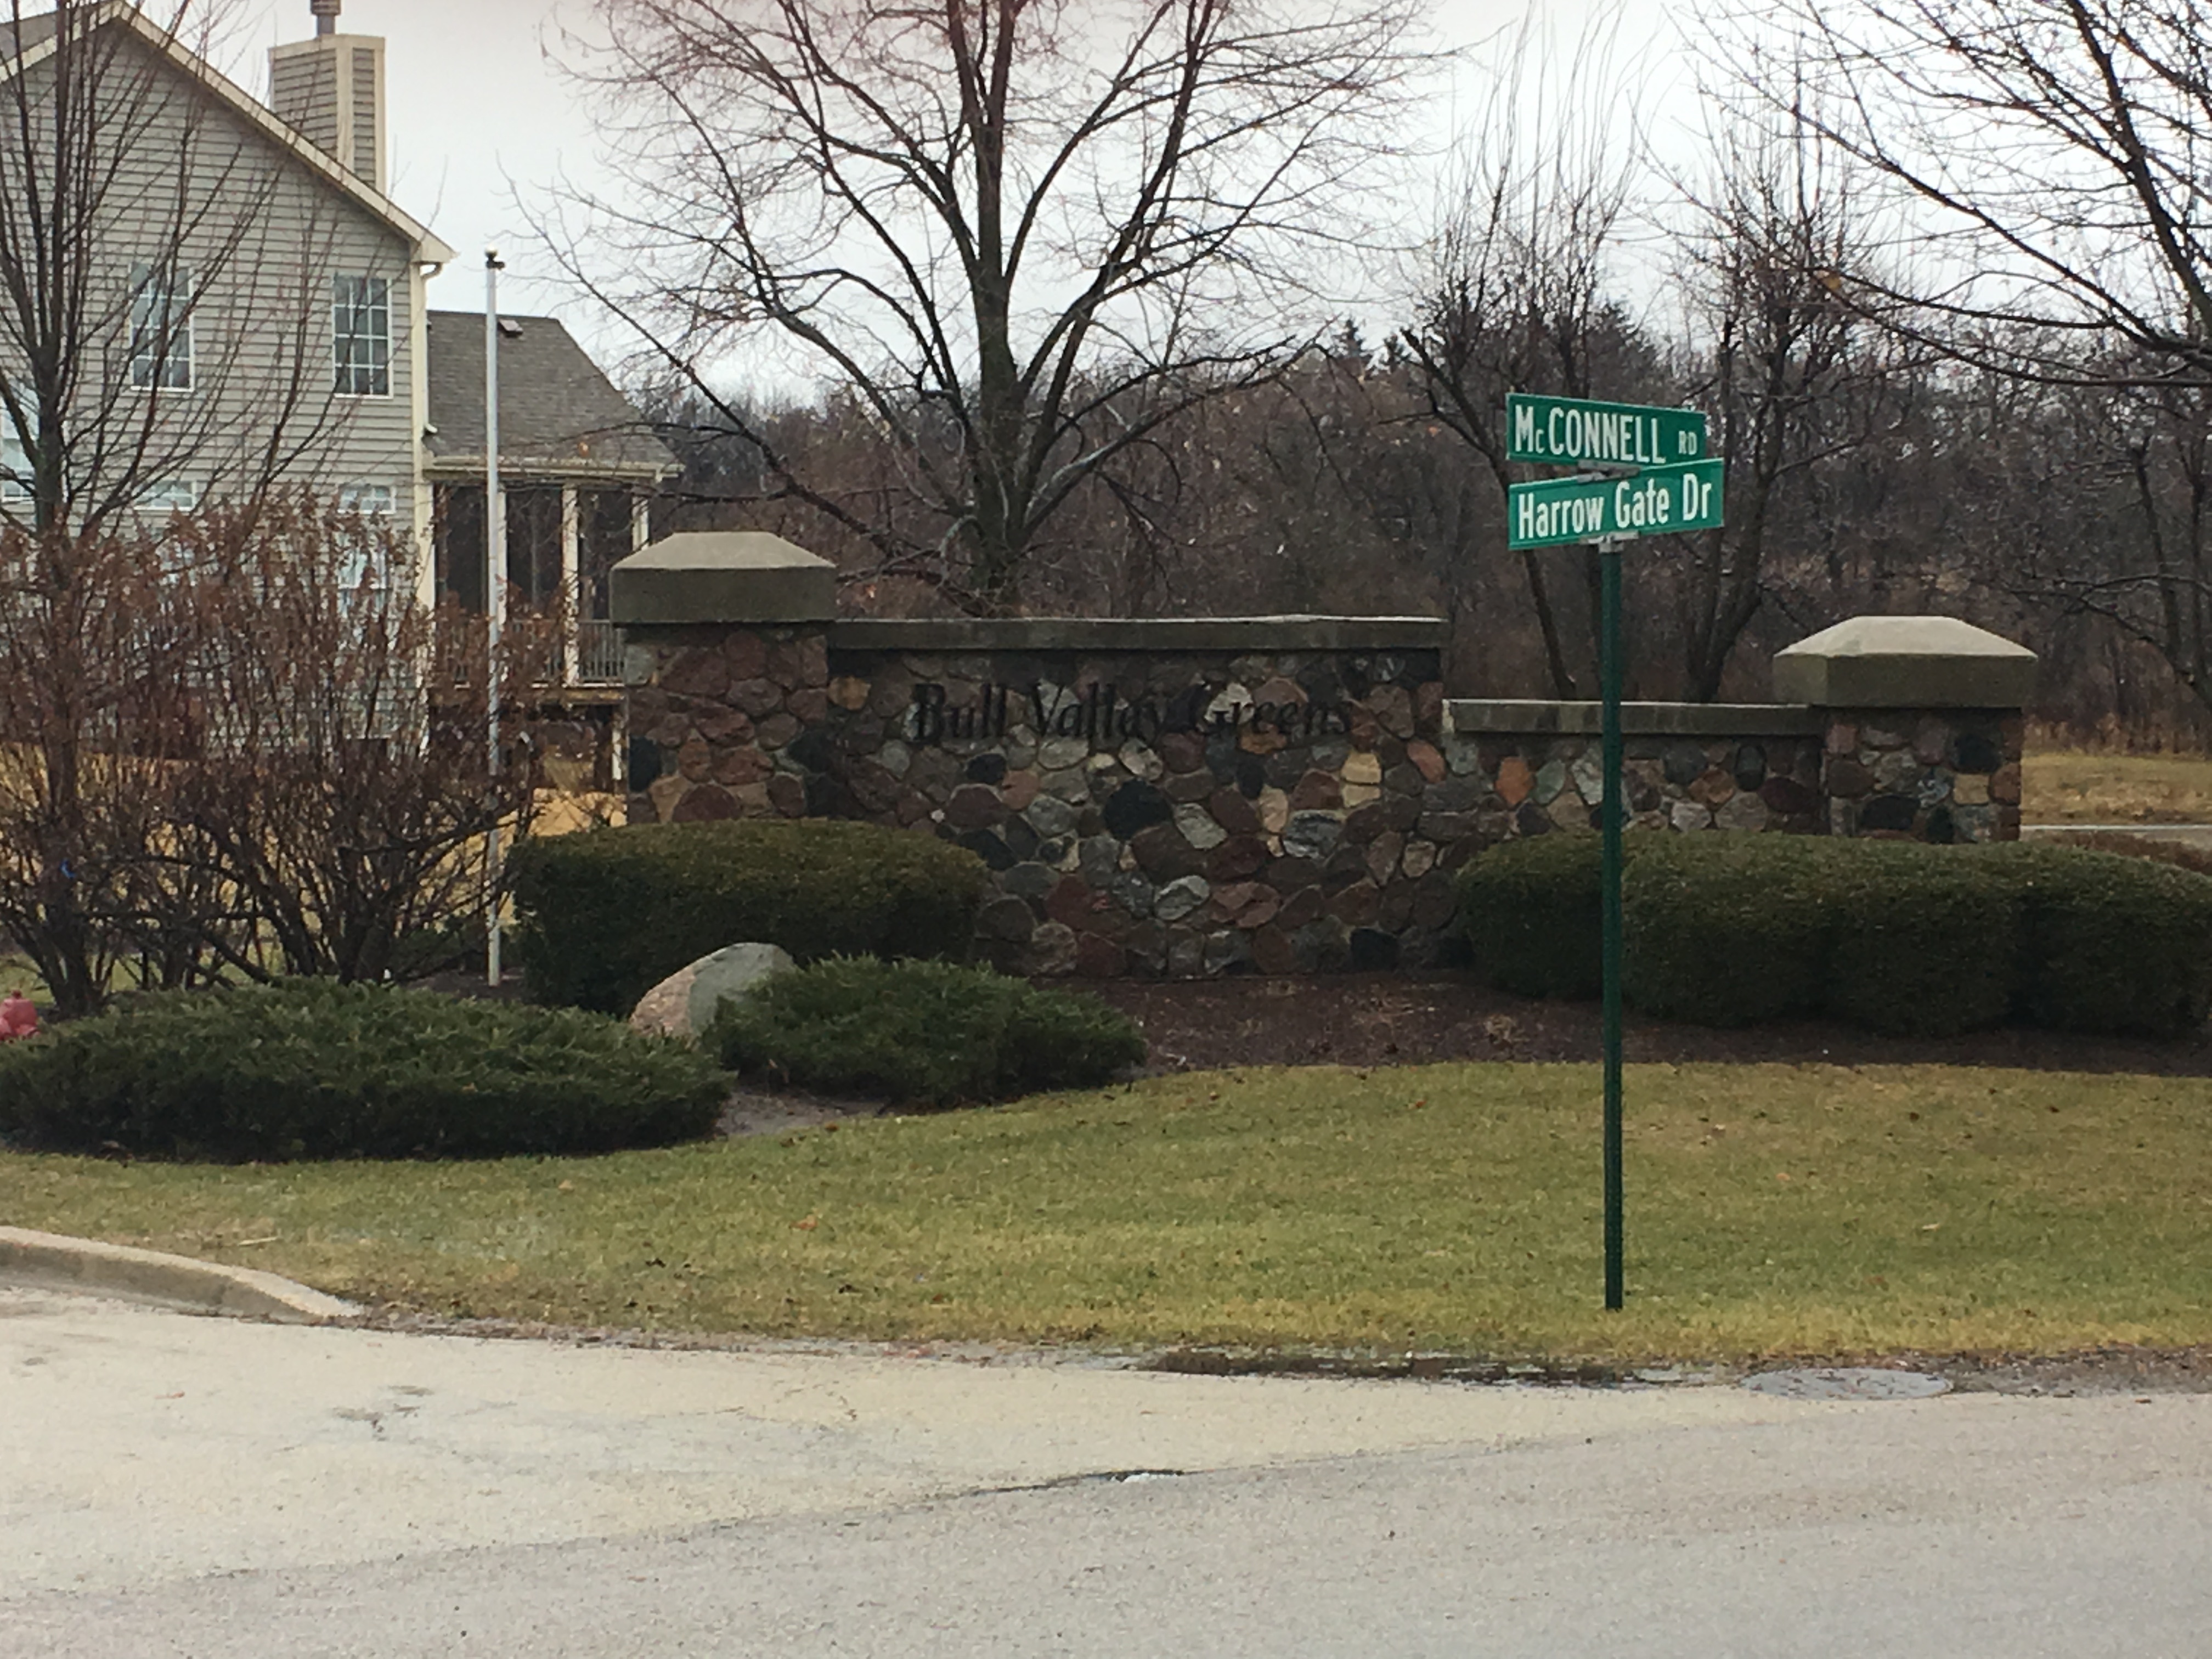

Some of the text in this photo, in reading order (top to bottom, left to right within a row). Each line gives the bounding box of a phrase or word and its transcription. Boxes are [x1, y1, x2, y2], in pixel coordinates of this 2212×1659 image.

[1515, 404, 1697, 464] McCONNELL RD
[1519, 473, 1712, 539] Harrow Gate Dr
[913, 682, 1007, 743] Bull
